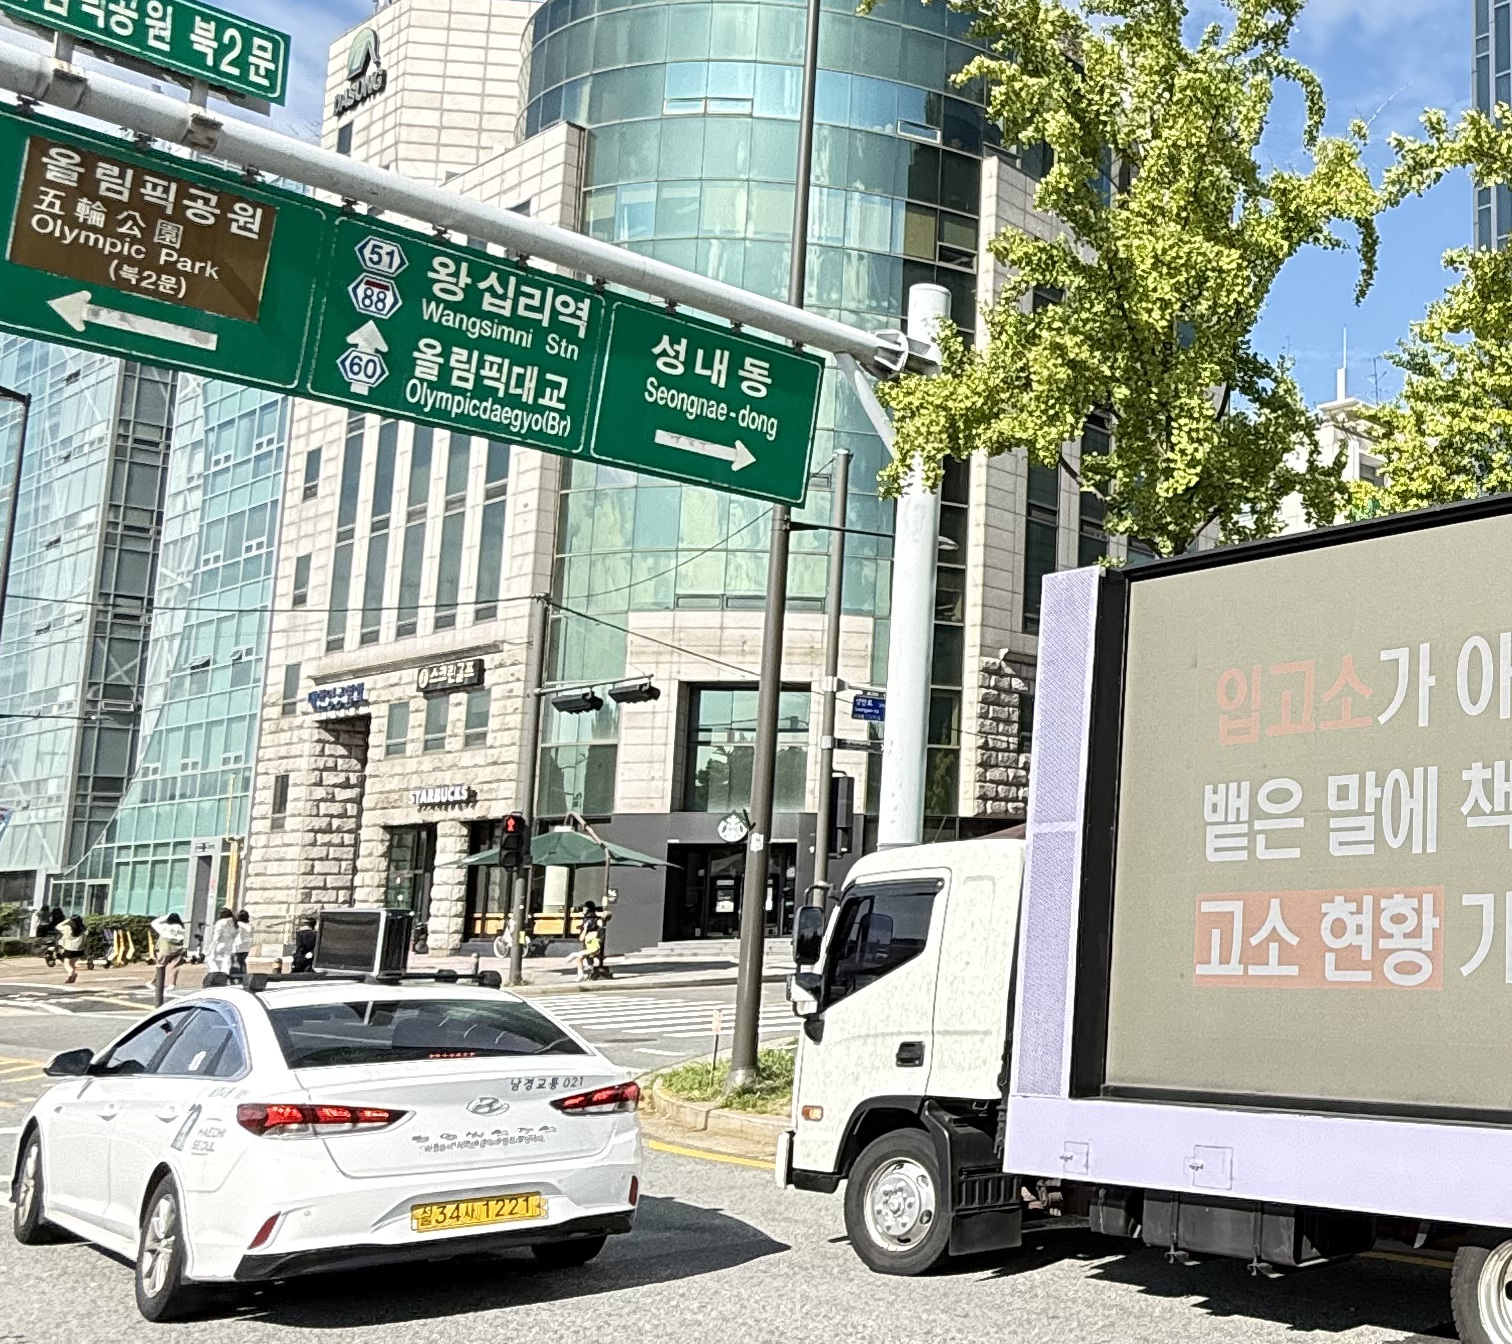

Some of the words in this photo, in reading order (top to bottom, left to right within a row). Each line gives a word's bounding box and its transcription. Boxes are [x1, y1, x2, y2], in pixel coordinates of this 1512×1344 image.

[190, 15, 276, 87] 북2문
[41, 147, 263, 239] 올림픽공원
[31, 214, 147, 259] Olympic
[159, 248, 220, 280] Park
[368, 244, 396, 269] 51
[109, 259, 187, 299] (북2문)
[361, 286, 387, 312] 88
[427, 256, 591, 339] 왕십리역
[422, 298, 533, 348] Wangsimni
[545, 333, 579, 361] Stn
[349, 356, 377, 380] 60
[413, 337, 569, 410] 올림픽대교
[651, 334, 772, 398] 성내동
[405, 378, 571, 438] Olympicdaegyo(Br)
[1217, 642, 1436, 746] 입고소가
[408, 783, 469, 805] STARBUCKS
[1203, 778, 1304, 862] 뱉은
[1327, 765, 1438, 856] 말에
[1195, 898, 1300, 977] 고소
[1319, 891, 1440, 987] 현황
[562, 1076, 584, 1088] 021
[484, 1195, 532, 1218] 1221
